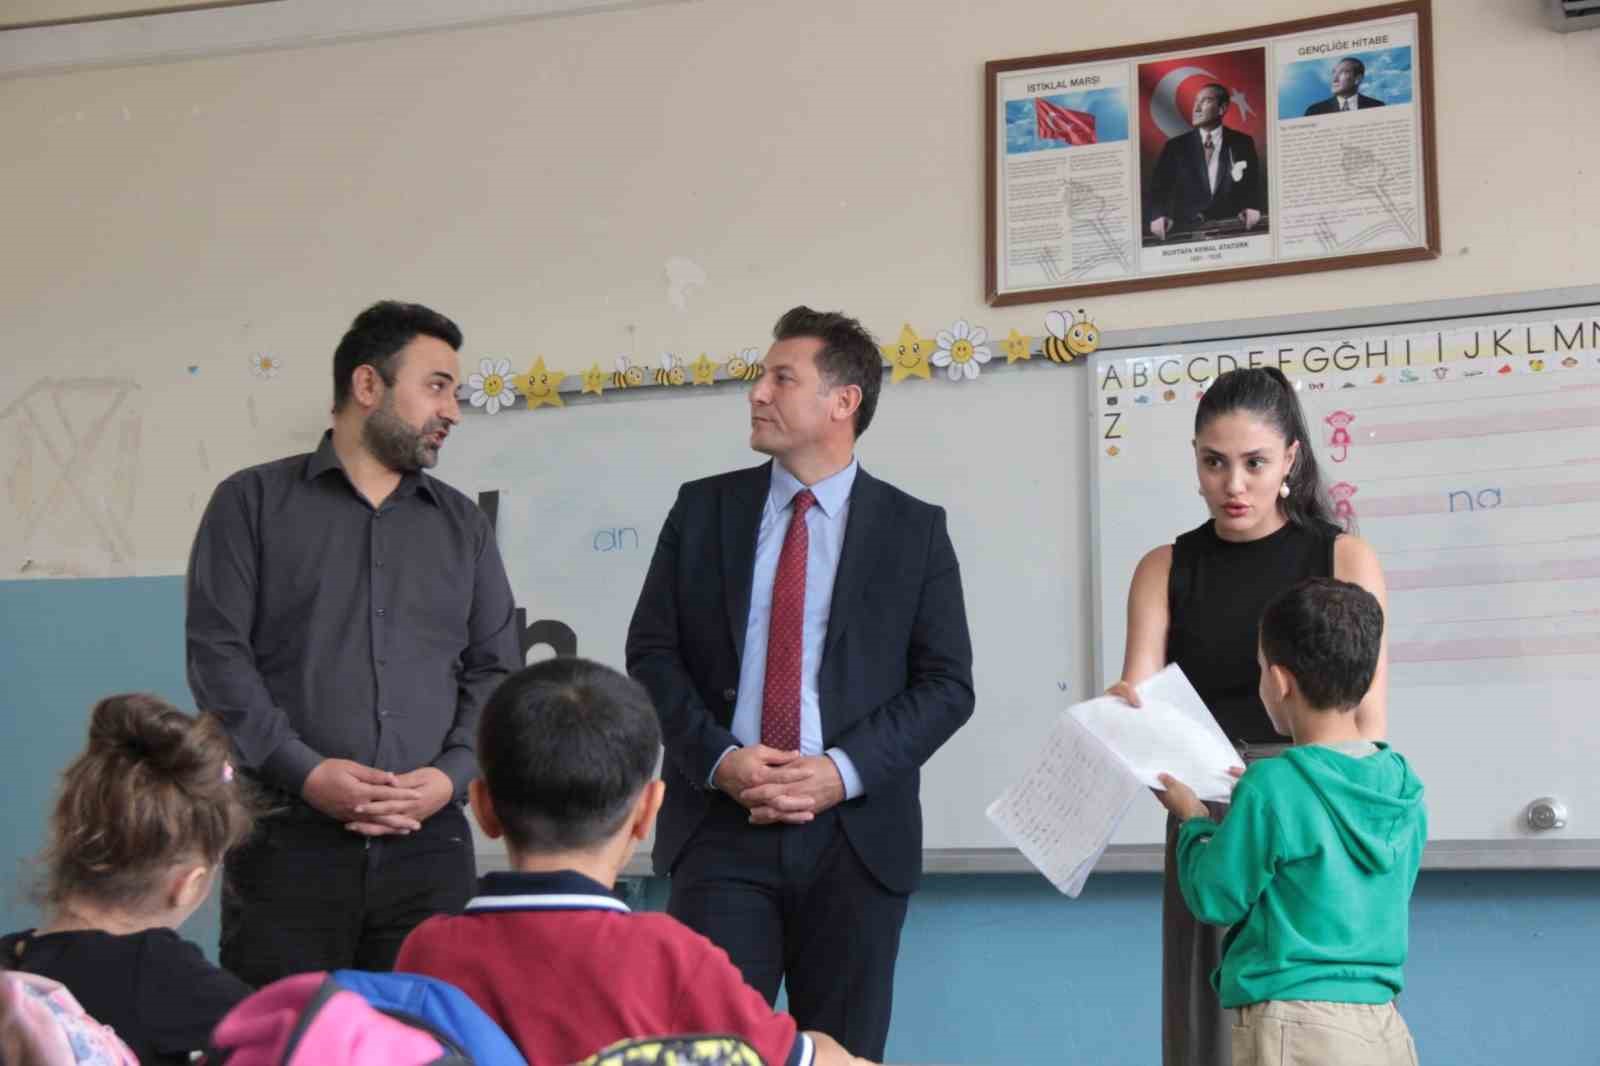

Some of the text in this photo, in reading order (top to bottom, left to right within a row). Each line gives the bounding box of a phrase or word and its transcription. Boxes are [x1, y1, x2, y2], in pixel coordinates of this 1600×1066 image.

[1102, 364, 1123, 391] A
[1132, 362, 1149, 388] B
[1158, 359, 1181, 385] C
[1303, 346, 1329, 373] G
[1333, 341, 1360, 371] Ğ
[1366, 339, 1388, 368] H
[1464, 331, 1480, 359] J
[1493, 328, 1513, 357] K
[1526, 327, 1545, 354] L
[1554, 321, 1585, 351] M
[1103, 412, 1123, 439] Z
[1447, 488, 1502, 512] na
[593, 527, 639, 552] an
